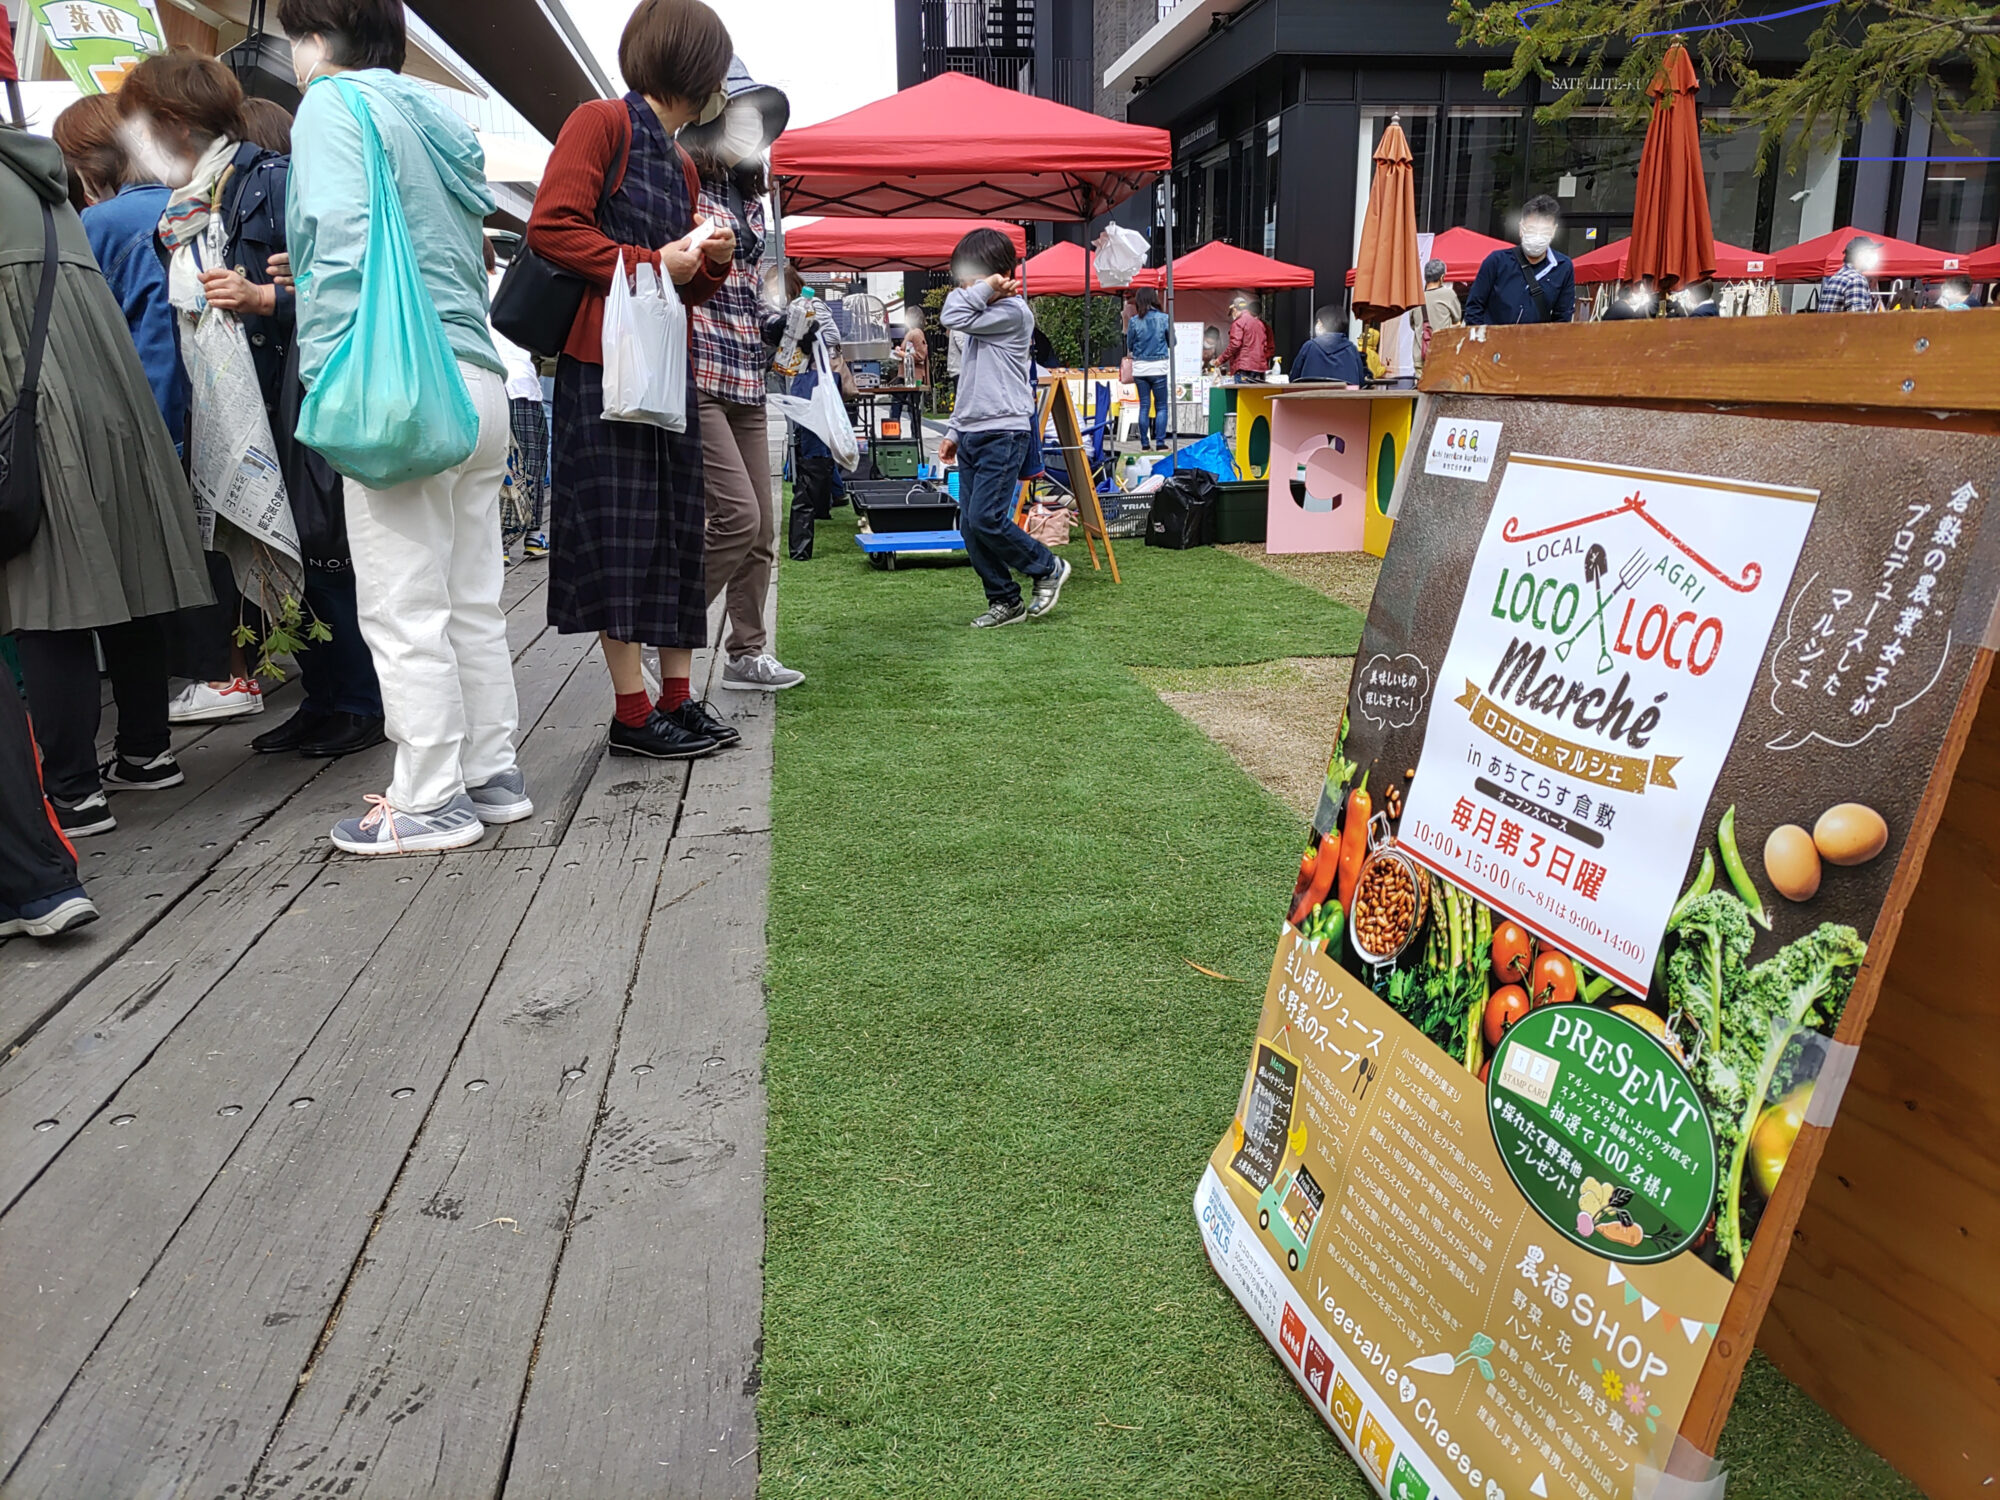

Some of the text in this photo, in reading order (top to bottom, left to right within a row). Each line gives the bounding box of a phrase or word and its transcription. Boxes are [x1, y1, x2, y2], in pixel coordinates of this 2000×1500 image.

[1122, 502, 1151, 510] TRIAL
[1527, 536, 1706, 604] LOCAL AGRI
[1823, 504, 1931, 696] プロデュースした
[1850, 480, 1979, 716] 倉敷の農業女子が
[1490, 567, 1724, 677] LOCO LOCO
[1791, 588, 1853, 689] マルシェ
[1369, 669, 1418, 688] 美味しいもの
[1488, 636, 1668, 749] Marché
[1467, 743, 1616, 831] in あちてらす倉敷
[1498, 791, 1568, 832] オープンスペース
[1451, 796, 1607, 902] 毎月第3日曜
[1284, 952, 1385, 1057] 生しぼりジュース
[1269, 1055, 1286, 1075] Menu
[1303, 1053, 1356, 1118] マルシェで売られている
[1394, 1066, 1464, 1136] マルシェを企画しました。
[1401, 1047, 1462, 1103] 小さな農家が集まり
[1502, 1072, 1549, 1102] STAMP CARD
[1545, 1013, 1699, 1138] PRESENT
[1377, 1106, 1502, 1230] いろんな理由で市場に出回らないけれど
[1203, 1206, 1230, 1254] GOALS
[1347, 1185, 1432, 1279] 食べ方を聞いてみてください。
[1515, 1245, 1668, 1382] 農福SHOP
[1317, 1276, 1483, 1488] Vegetable Cheese
[1336, 1374, 1344, 1390] 12
[1505, 1314, 1639, 1447] ハンドメイド焼き菓子
[1398, 1458, 1407, 1472] 15
[1477, 1404, 1522, 1464] 推進します。
